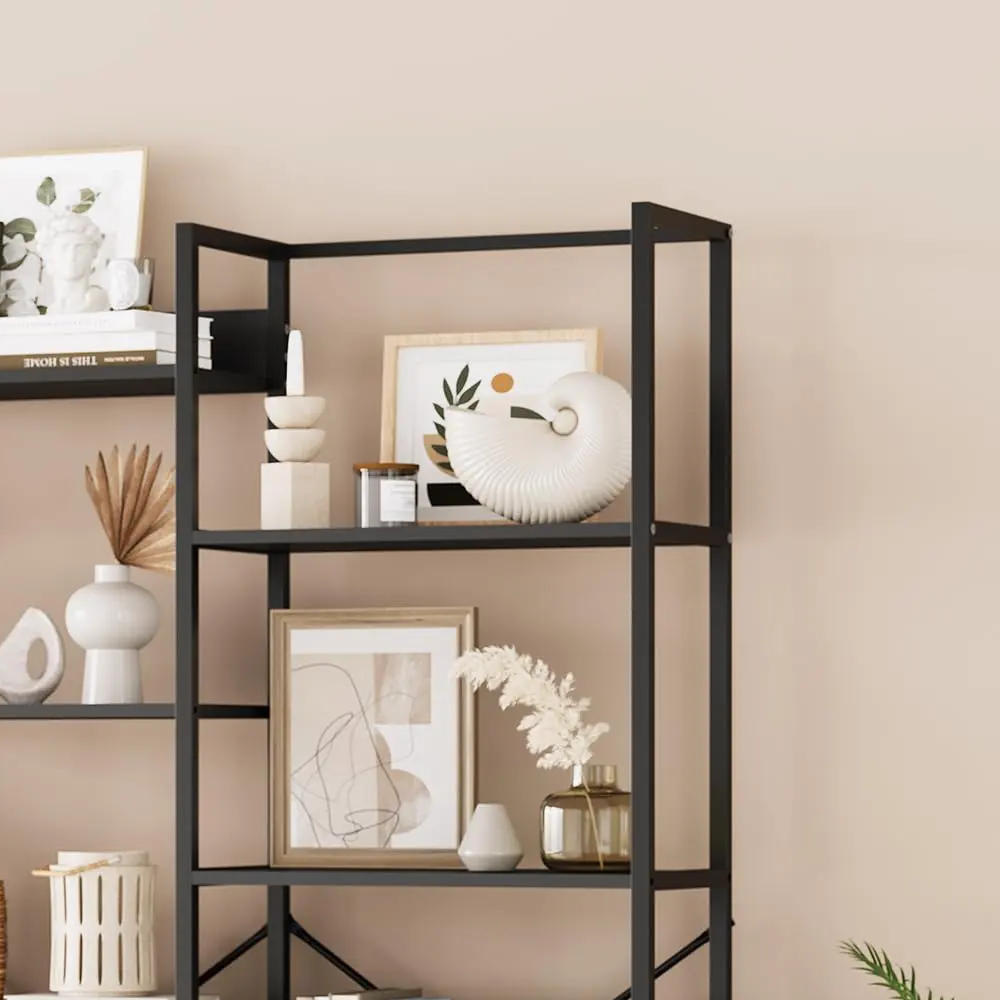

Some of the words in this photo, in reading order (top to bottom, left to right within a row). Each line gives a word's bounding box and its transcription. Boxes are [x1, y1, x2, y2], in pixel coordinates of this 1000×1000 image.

[24, 356, 57, 368] HOME
[60, 356, 70, 367] IS
[72, 354, 98, 367] THIS
